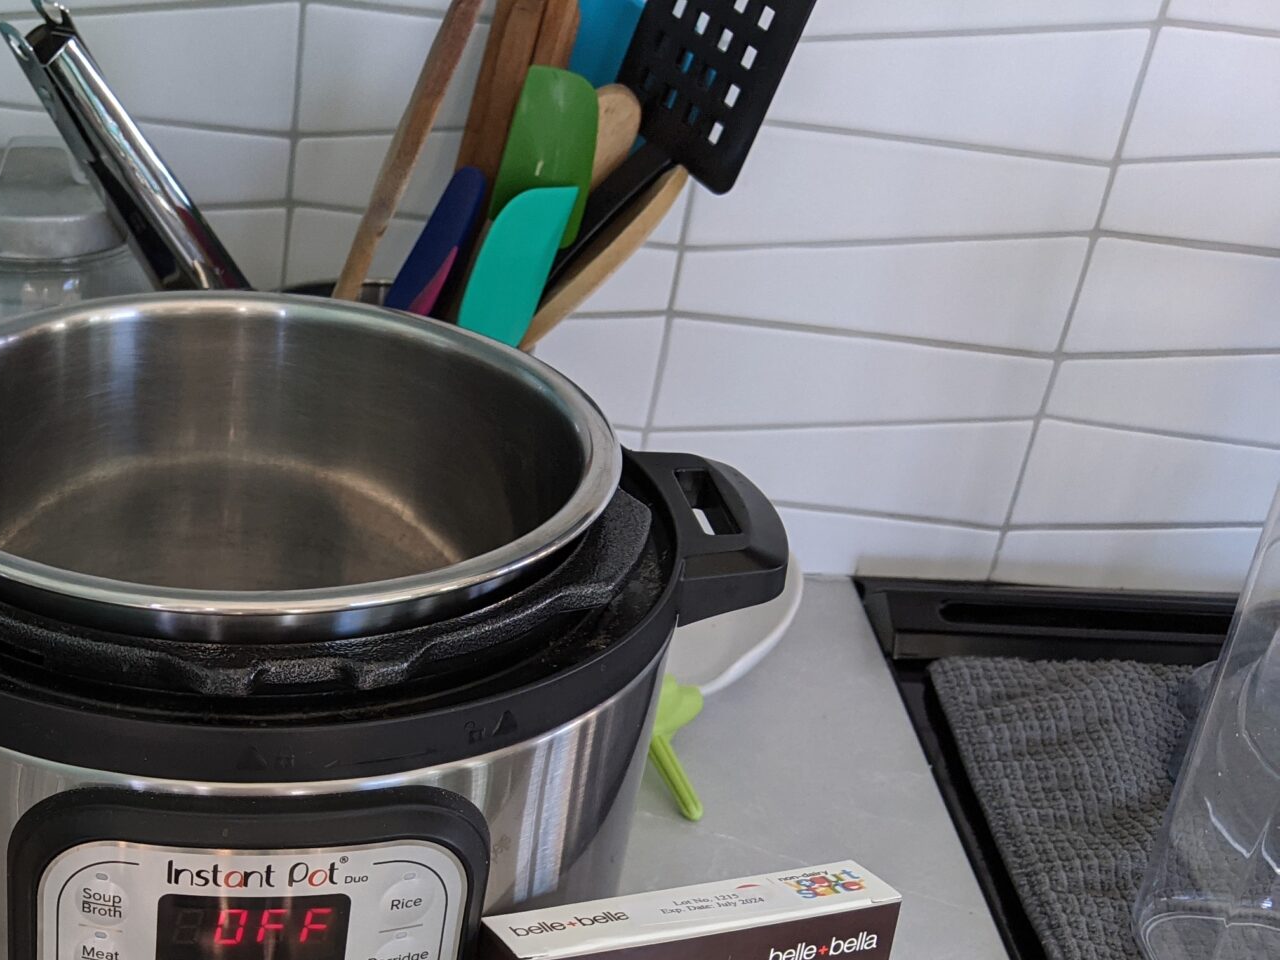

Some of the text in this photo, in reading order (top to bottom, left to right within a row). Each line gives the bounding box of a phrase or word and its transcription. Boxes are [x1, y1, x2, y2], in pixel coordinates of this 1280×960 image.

[166, 860, 369, 888] Instant Pot Duo
[82, 887, 123, 907] Soup
[389, 896, 423, 911] Rice
[672, 898, 694, 907] Lot
[738, 896, 765, 905] 2024
[81, 900, 123, 919] Broth
[213, 907, 333, 946] OFF
